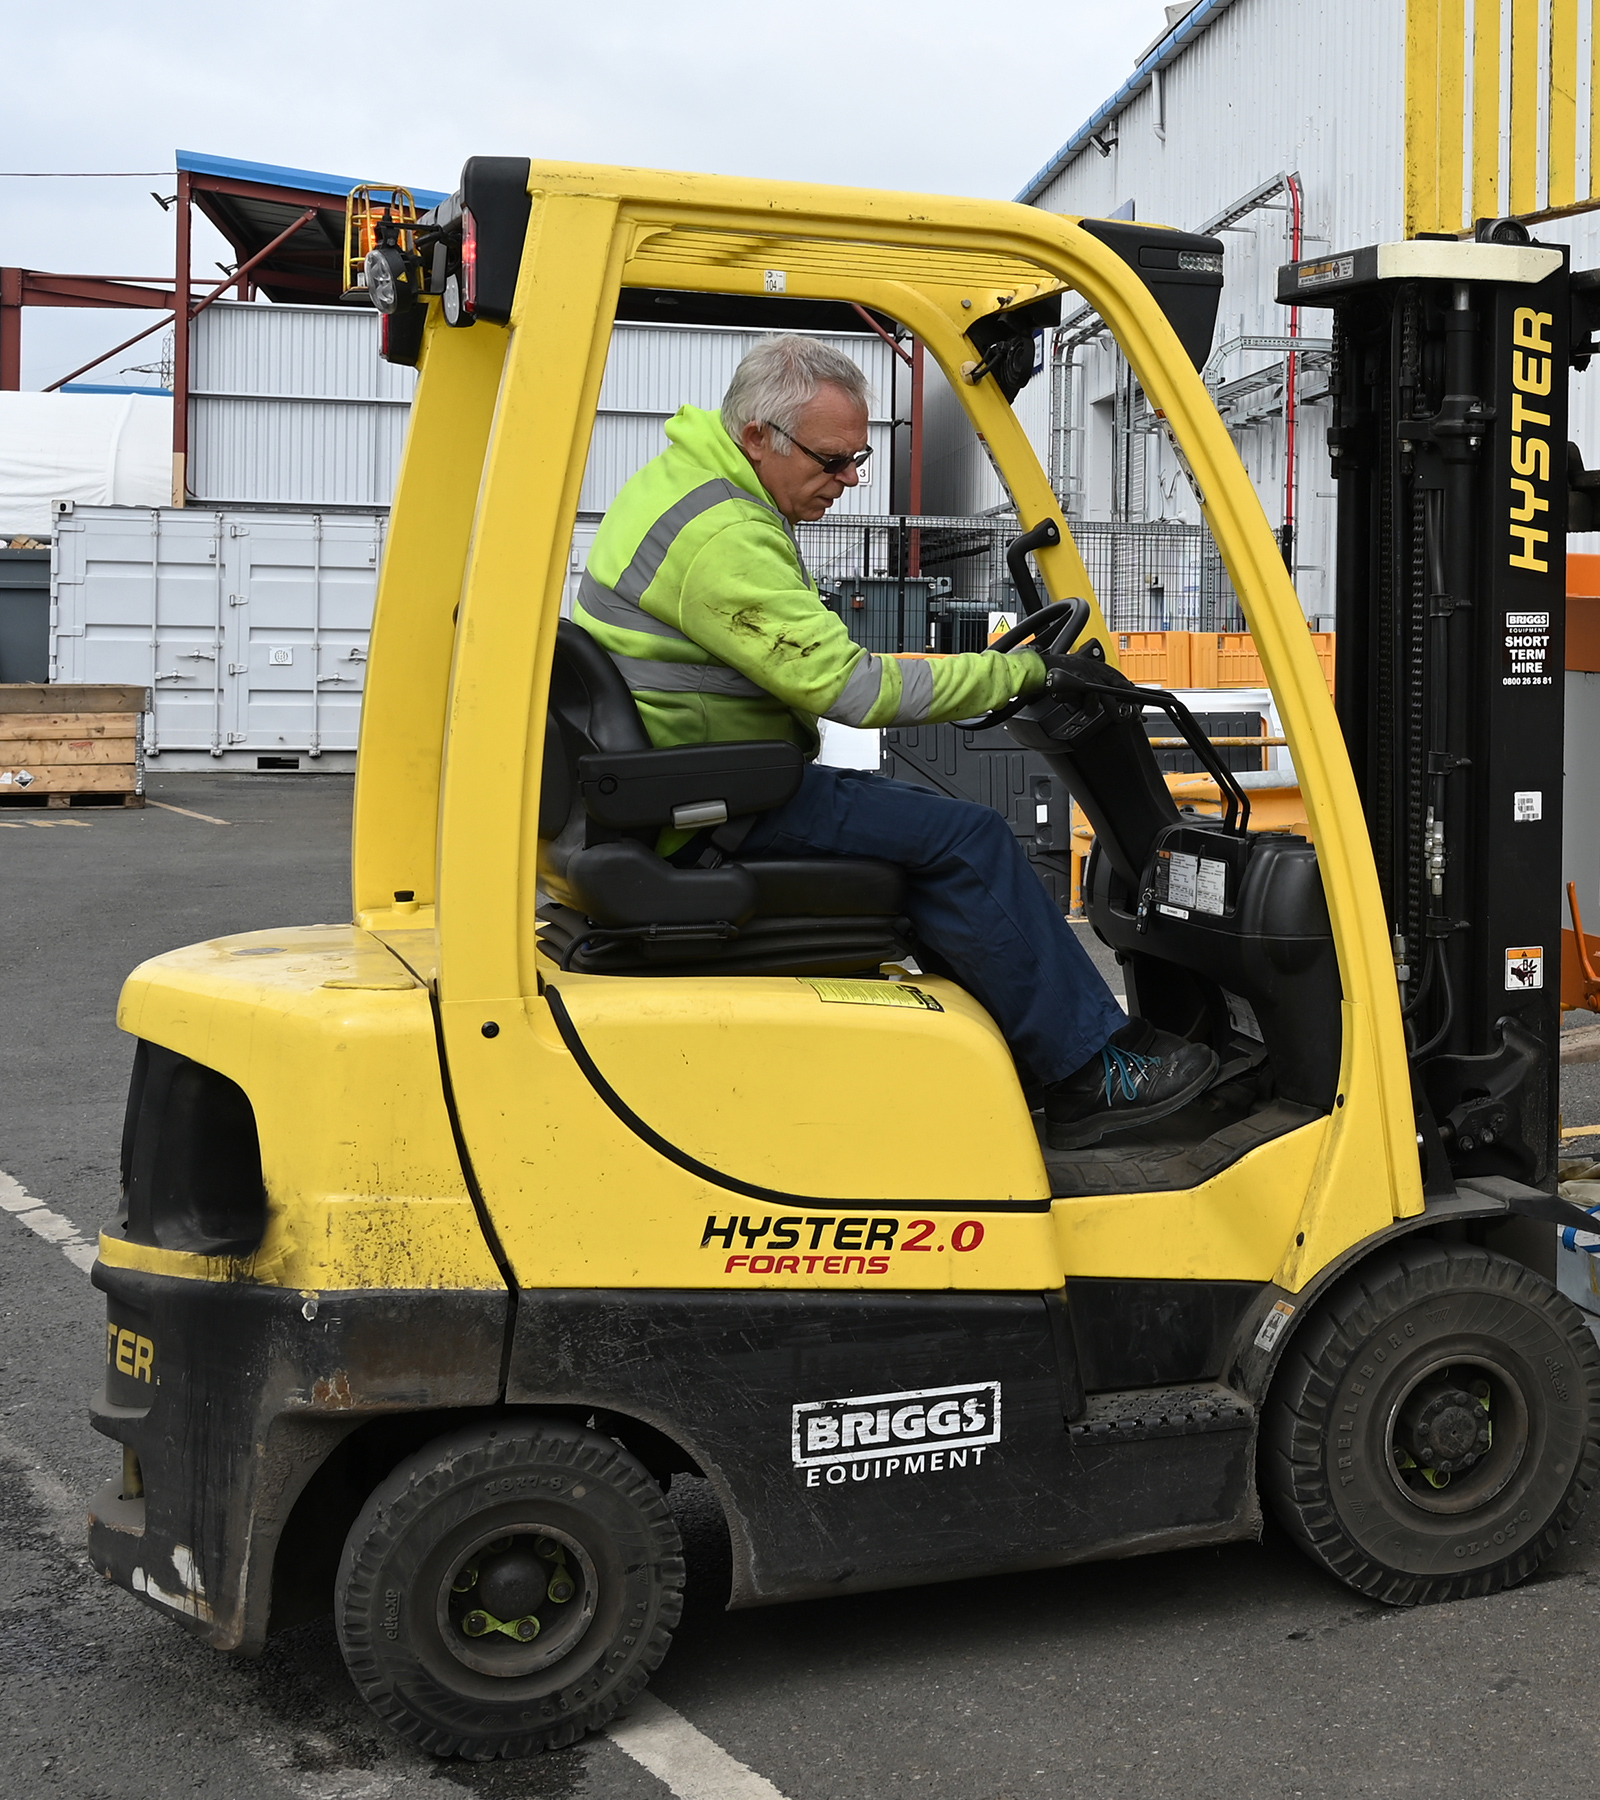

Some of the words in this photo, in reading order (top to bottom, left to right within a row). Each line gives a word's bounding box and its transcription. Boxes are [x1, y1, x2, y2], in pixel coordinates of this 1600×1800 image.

[766, 279, 777, 291] 104
[1508, 306, 1553, 574] HYSTER
[1509, 615, 1547, 625] BRIGGS
[1504, 636, 1550, 648] SHORT
[1509, 648, 1546, 661] TERM
[1512, 662, 1543, 674] HIRE
[1502, 677, 1522, 686] 0800
[1522, 677, 1532, 685] 26
[1532, 676, 1542, 685] 26
[1542, 676, 1552, 685] 81
[700, 1215, 900, 1251] HYSTER
[900, 1219, 986, 1252] 2.0
[724, 1254, 891, 1275] FORTENS
[1337, 1322, 1417, 1489] TRELLEBORG
[806, 1397, 987, 1452] BRIGGS
[806, 1446, 987, 1488] EQUIPMENT
